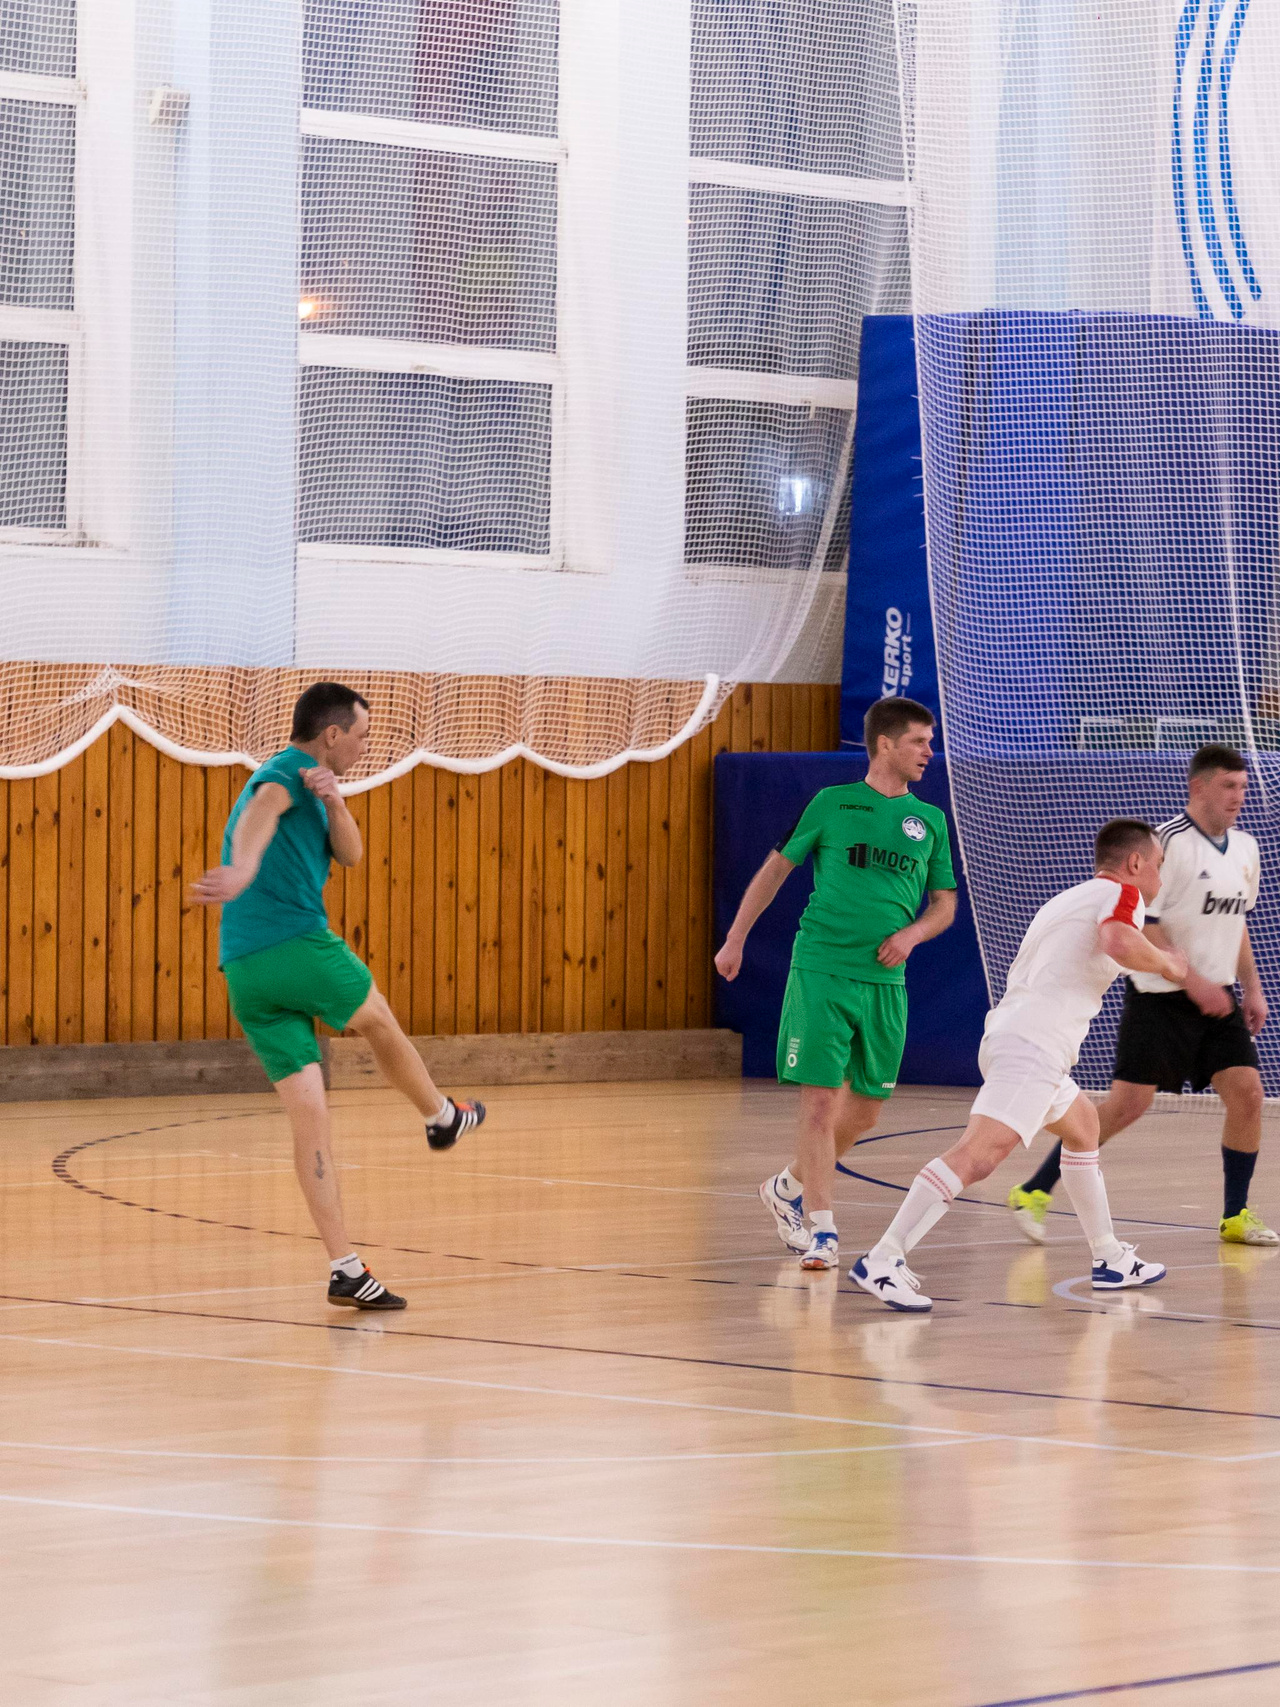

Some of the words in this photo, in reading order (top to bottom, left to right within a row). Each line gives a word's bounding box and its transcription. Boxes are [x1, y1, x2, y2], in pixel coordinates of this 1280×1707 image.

[880, 607, 903, 699] KERKO
[901, 634, 913, 687] sport
[840, 804, 874, 812] macron
